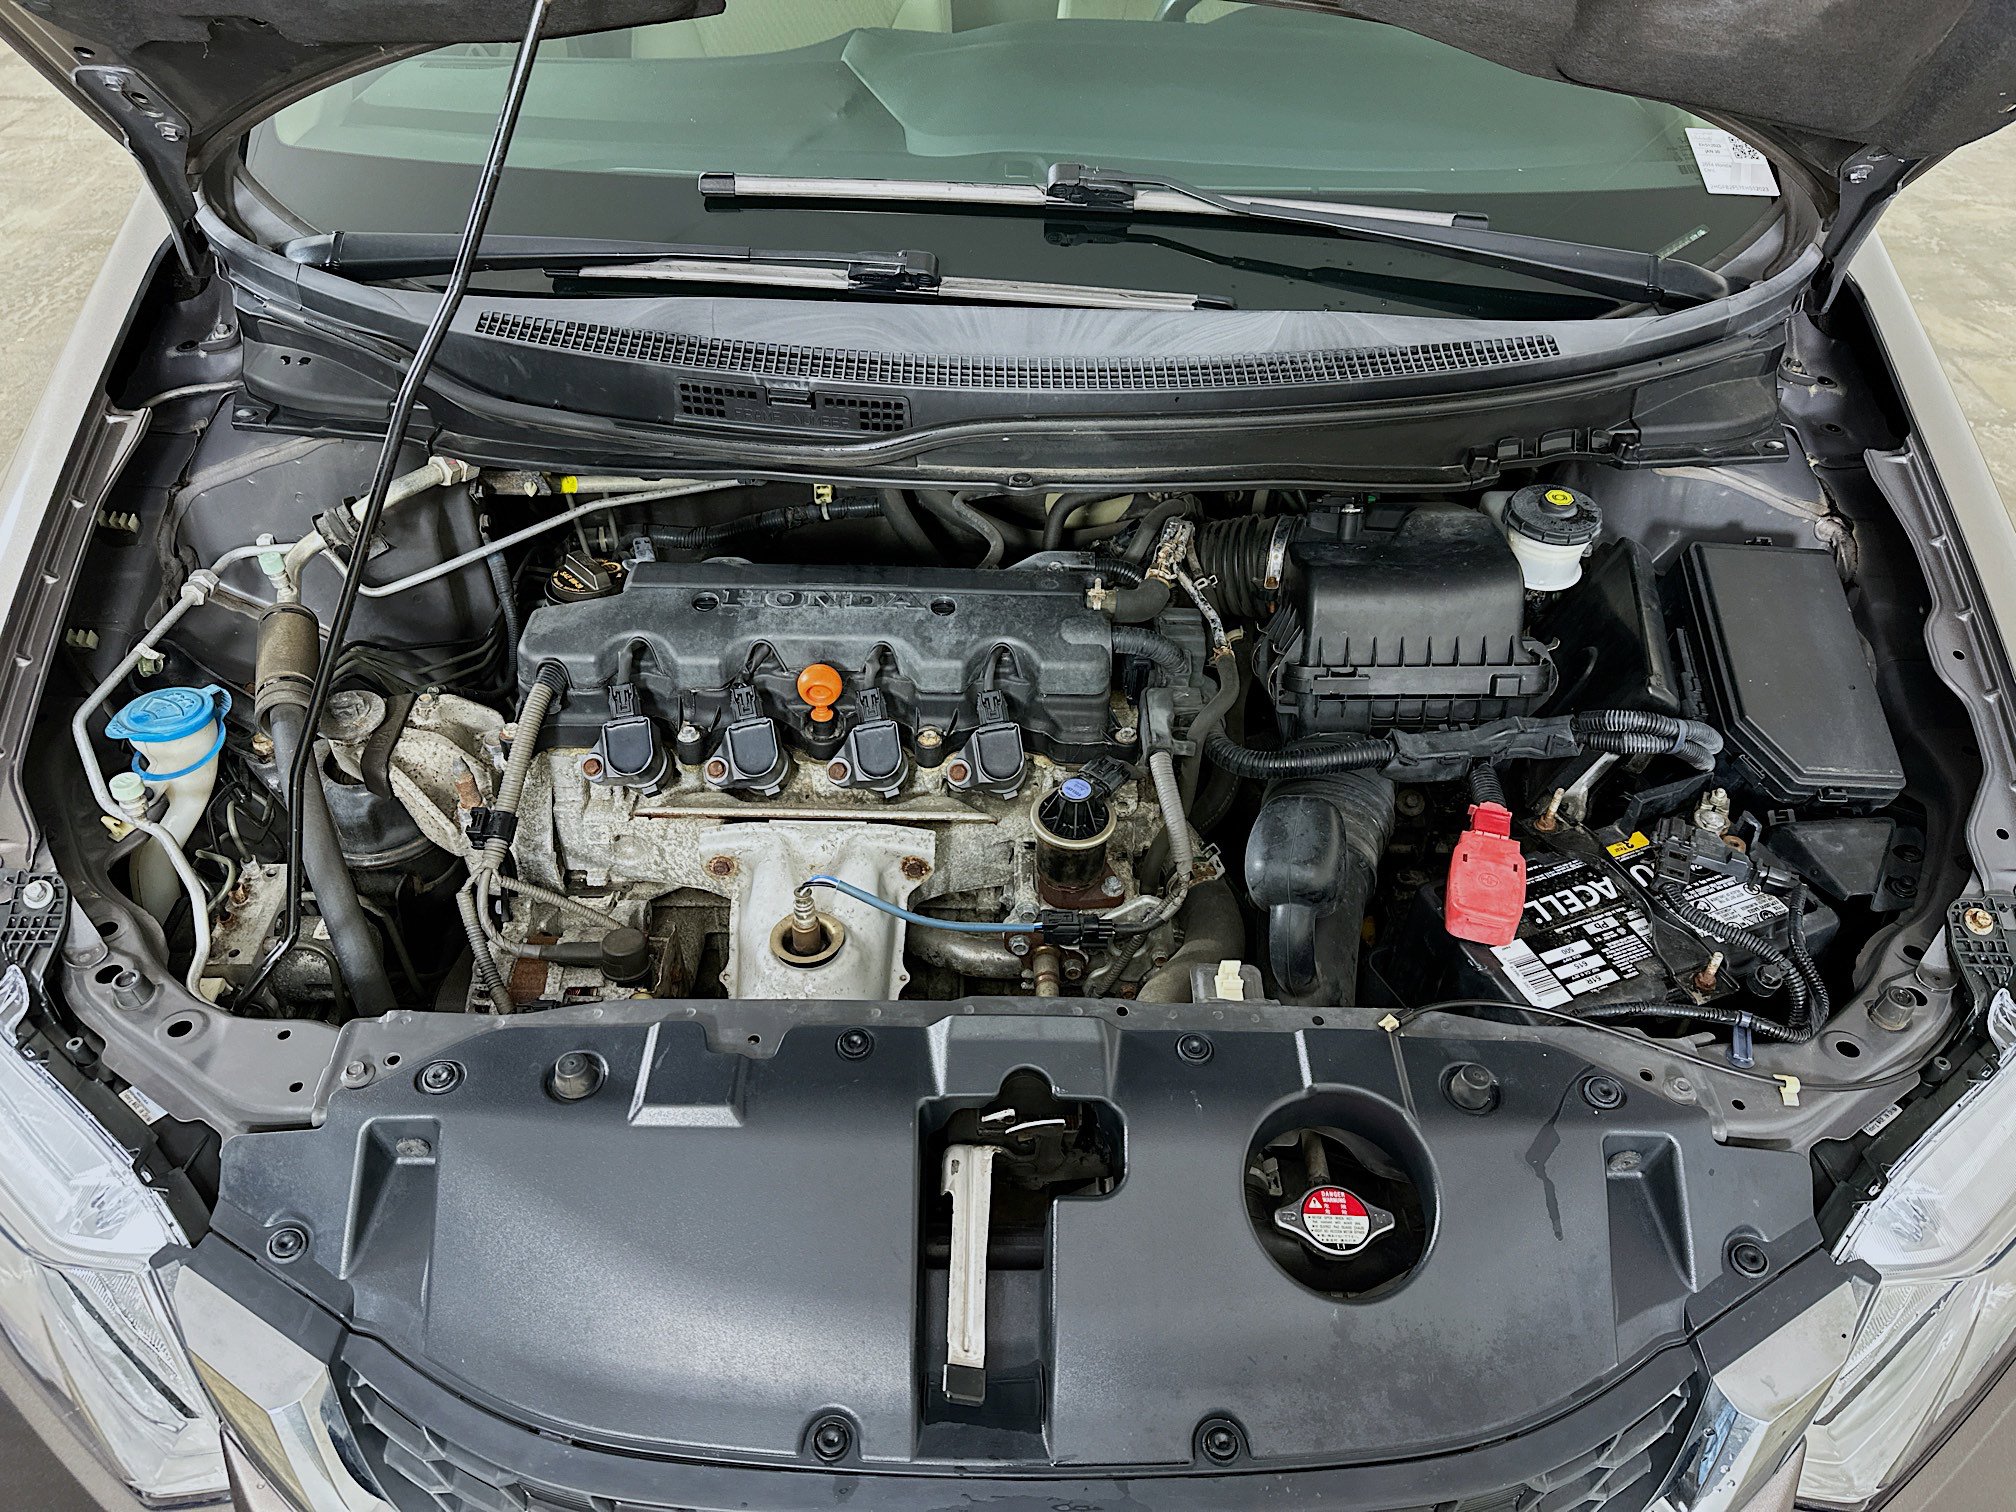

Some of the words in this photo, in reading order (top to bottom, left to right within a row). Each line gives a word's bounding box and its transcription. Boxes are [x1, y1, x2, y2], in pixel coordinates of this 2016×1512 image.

[734, 408, 782, 422] FRAME
[792, 413, 850, 428] NUMBER
[720, 588, 927, 610] HONDA
[1593, 919, 1610, 930] Pb
[1320, 1190, 1346, 1198] DANGER
